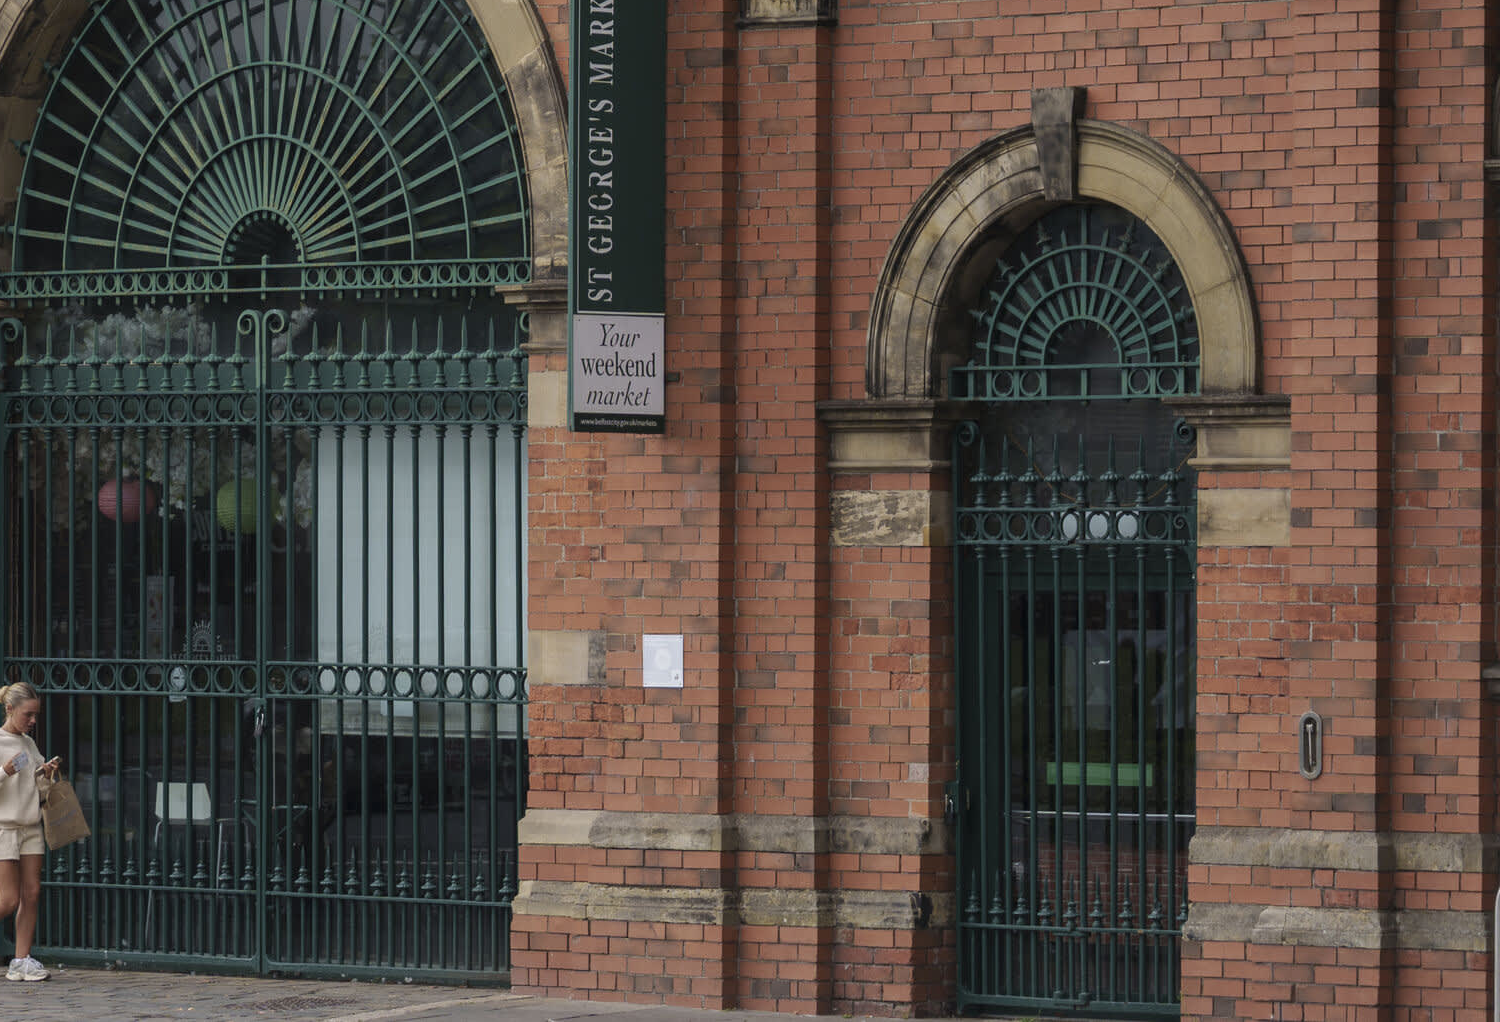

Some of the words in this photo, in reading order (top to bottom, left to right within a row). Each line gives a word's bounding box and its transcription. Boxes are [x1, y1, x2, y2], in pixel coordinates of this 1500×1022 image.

[588, 268, 612, 302] ST
[599, 323, 641, 348] Your
[581, 351, 656, 378] weekend
[586, 380, 651, 407] market
